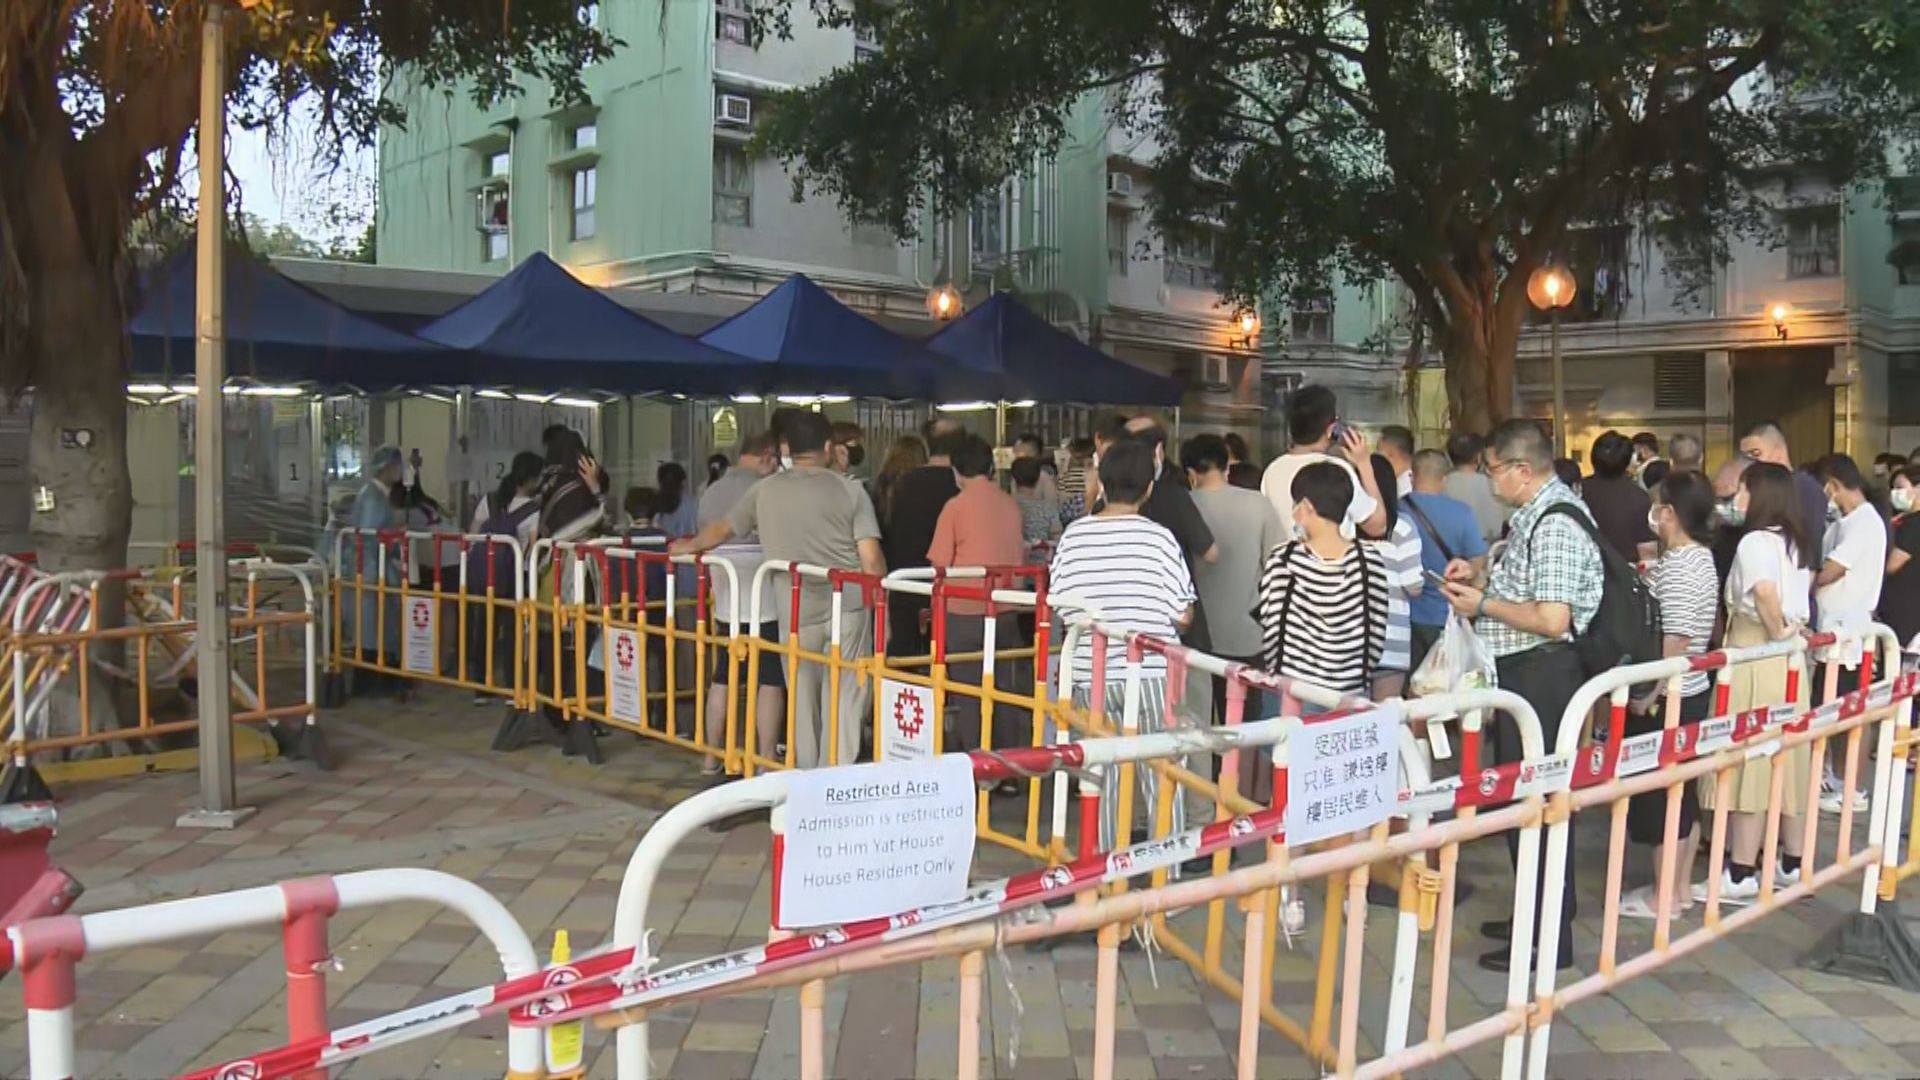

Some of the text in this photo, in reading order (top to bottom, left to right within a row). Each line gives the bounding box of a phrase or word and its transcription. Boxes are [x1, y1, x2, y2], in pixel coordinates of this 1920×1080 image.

[1314, 722, 1379, 758] 受限區域
[826, 779, 939, 802] Restricted Area
[798, 804, 964, 833] Admission is restricted
[817, 834, 944, 859] to Him Yat House
[803, 857, 955, 888] House Resident Only
